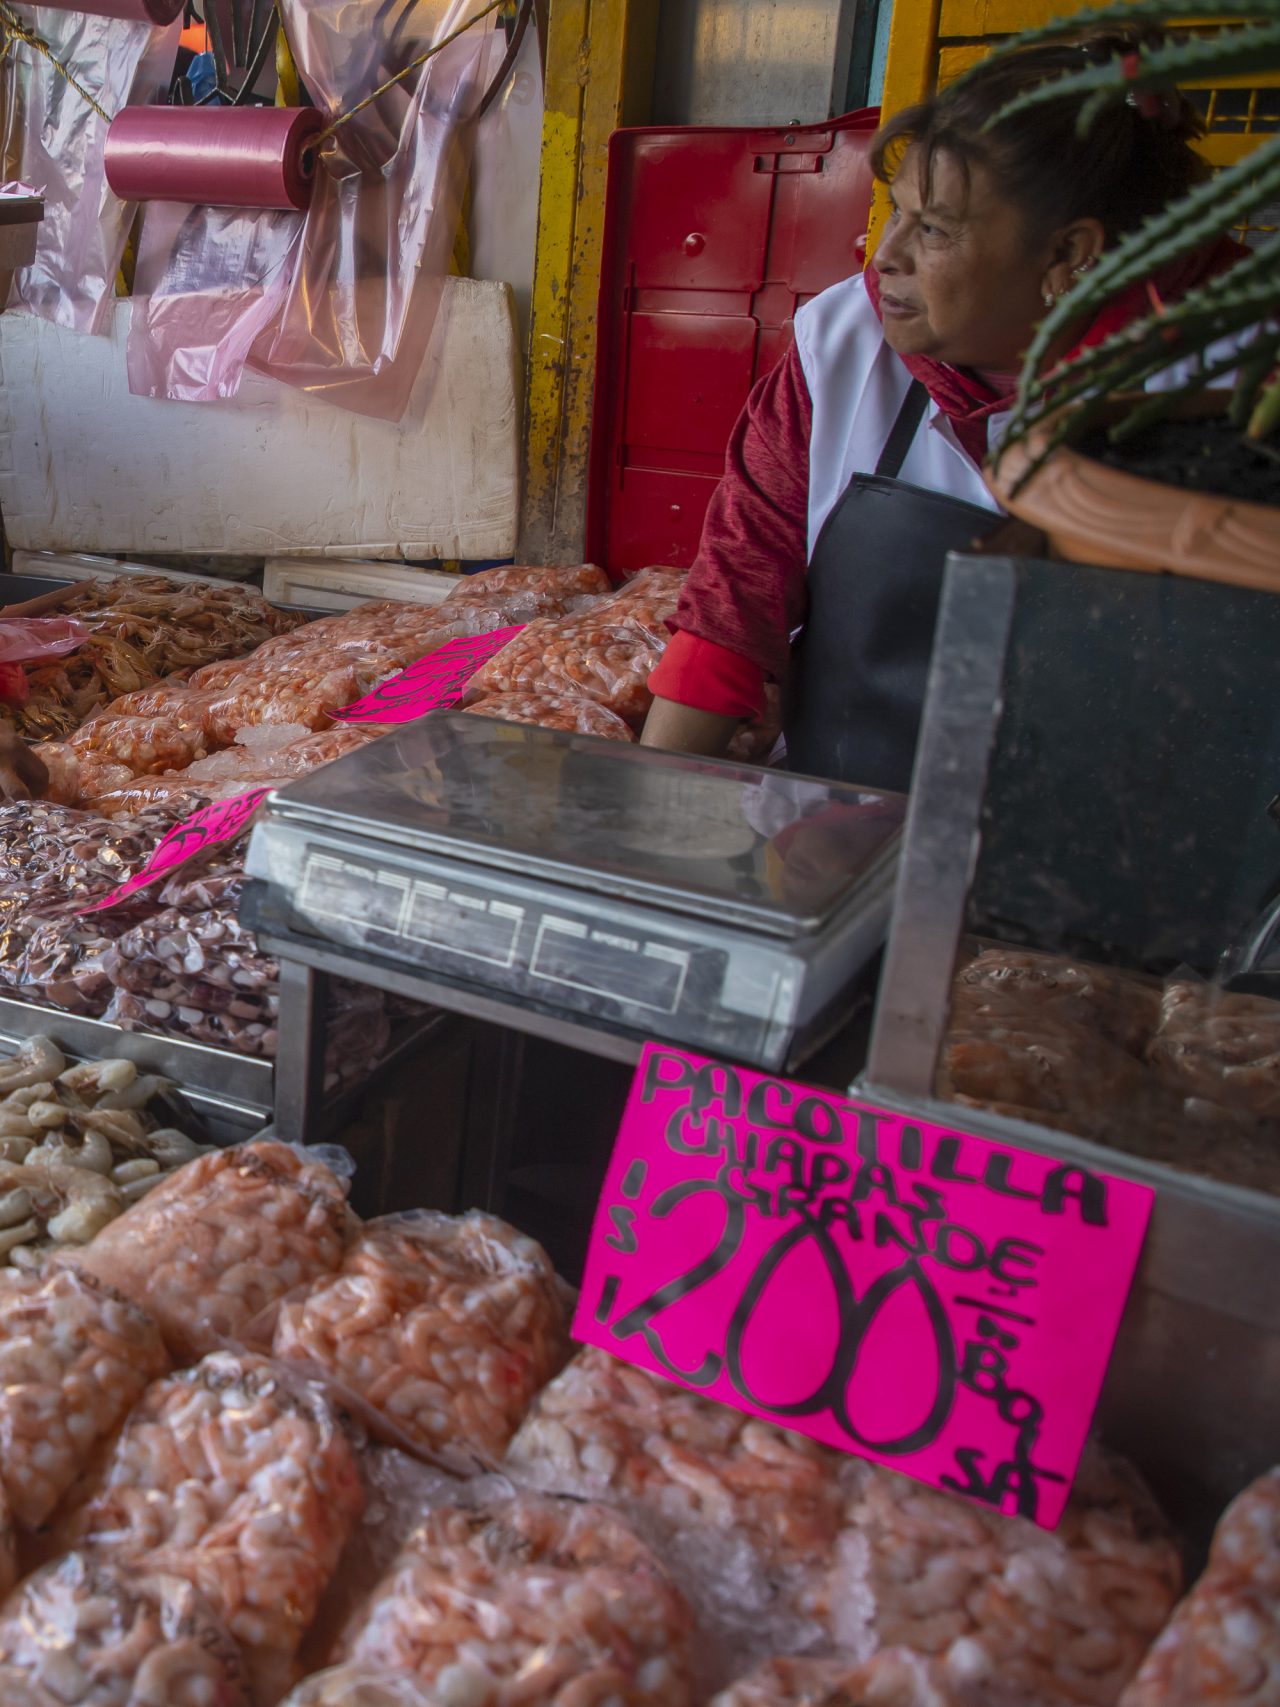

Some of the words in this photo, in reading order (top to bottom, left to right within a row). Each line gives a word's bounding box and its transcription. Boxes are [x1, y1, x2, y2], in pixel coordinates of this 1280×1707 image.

[641, 1051, 1109, 1227] PACOTILLA
[665, 1102, 950, 1222] CHIAPAS
[720, 1162, 1046, 1288] GRANDE
